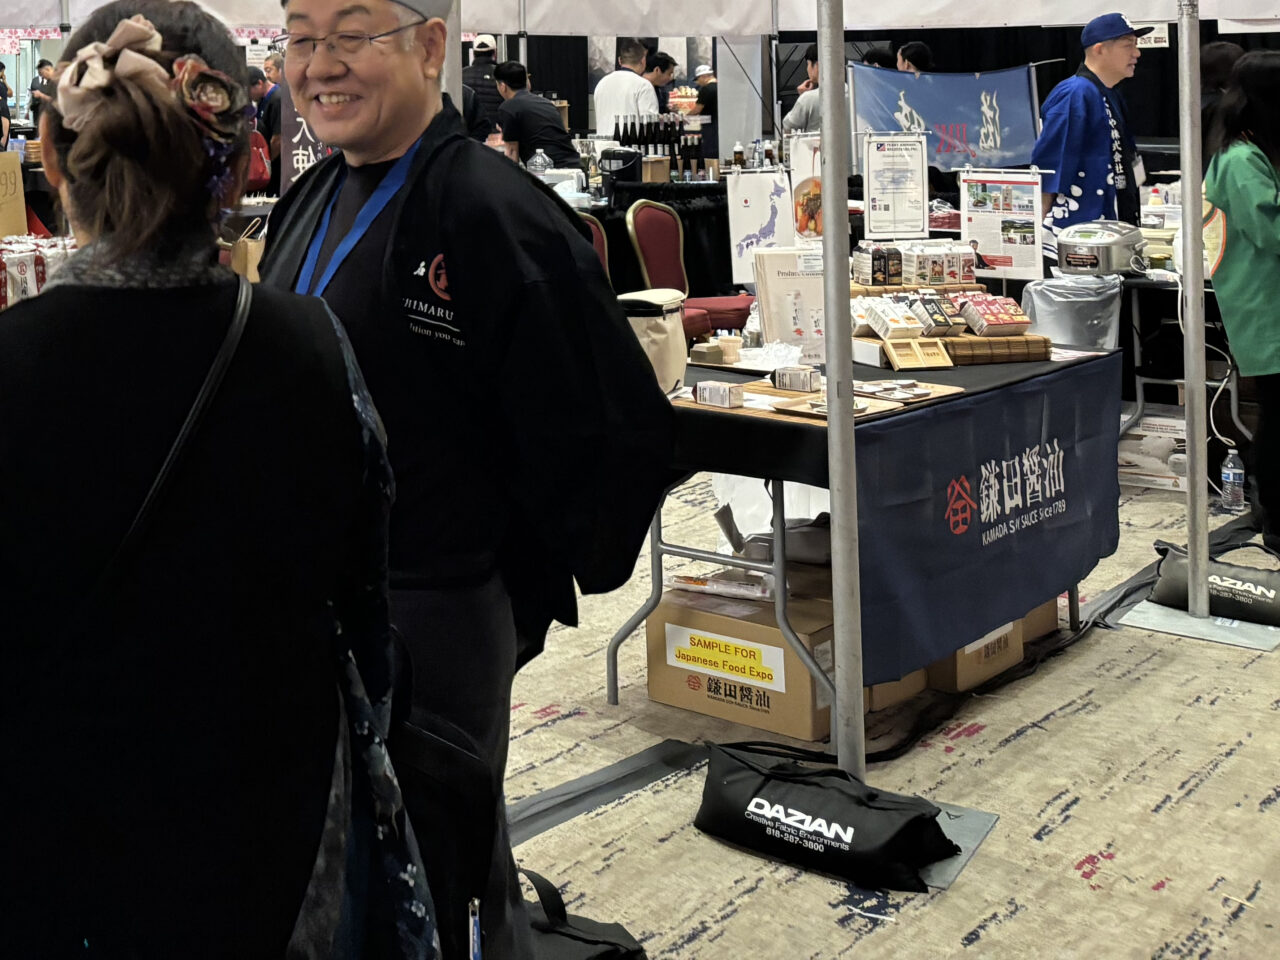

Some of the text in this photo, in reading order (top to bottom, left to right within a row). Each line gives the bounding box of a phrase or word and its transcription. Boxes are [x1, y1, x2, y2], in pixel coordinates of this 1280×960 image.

[982, 522, 1008, 546] KAMADA
[1021, 509, 1038, 529] SAUCE
[1208, 575, 1276, 599] AZIAN
[1209, 589, 1253, 604] 18-287-3800
[689, 636, 757, 660] SAMPLE FOR
[675, 649, 774, 681] Japanese Food Expo
[745, 811, 850, 851] Creative Fabric Environments
[747, 798, 855, 844] DAZIAN
